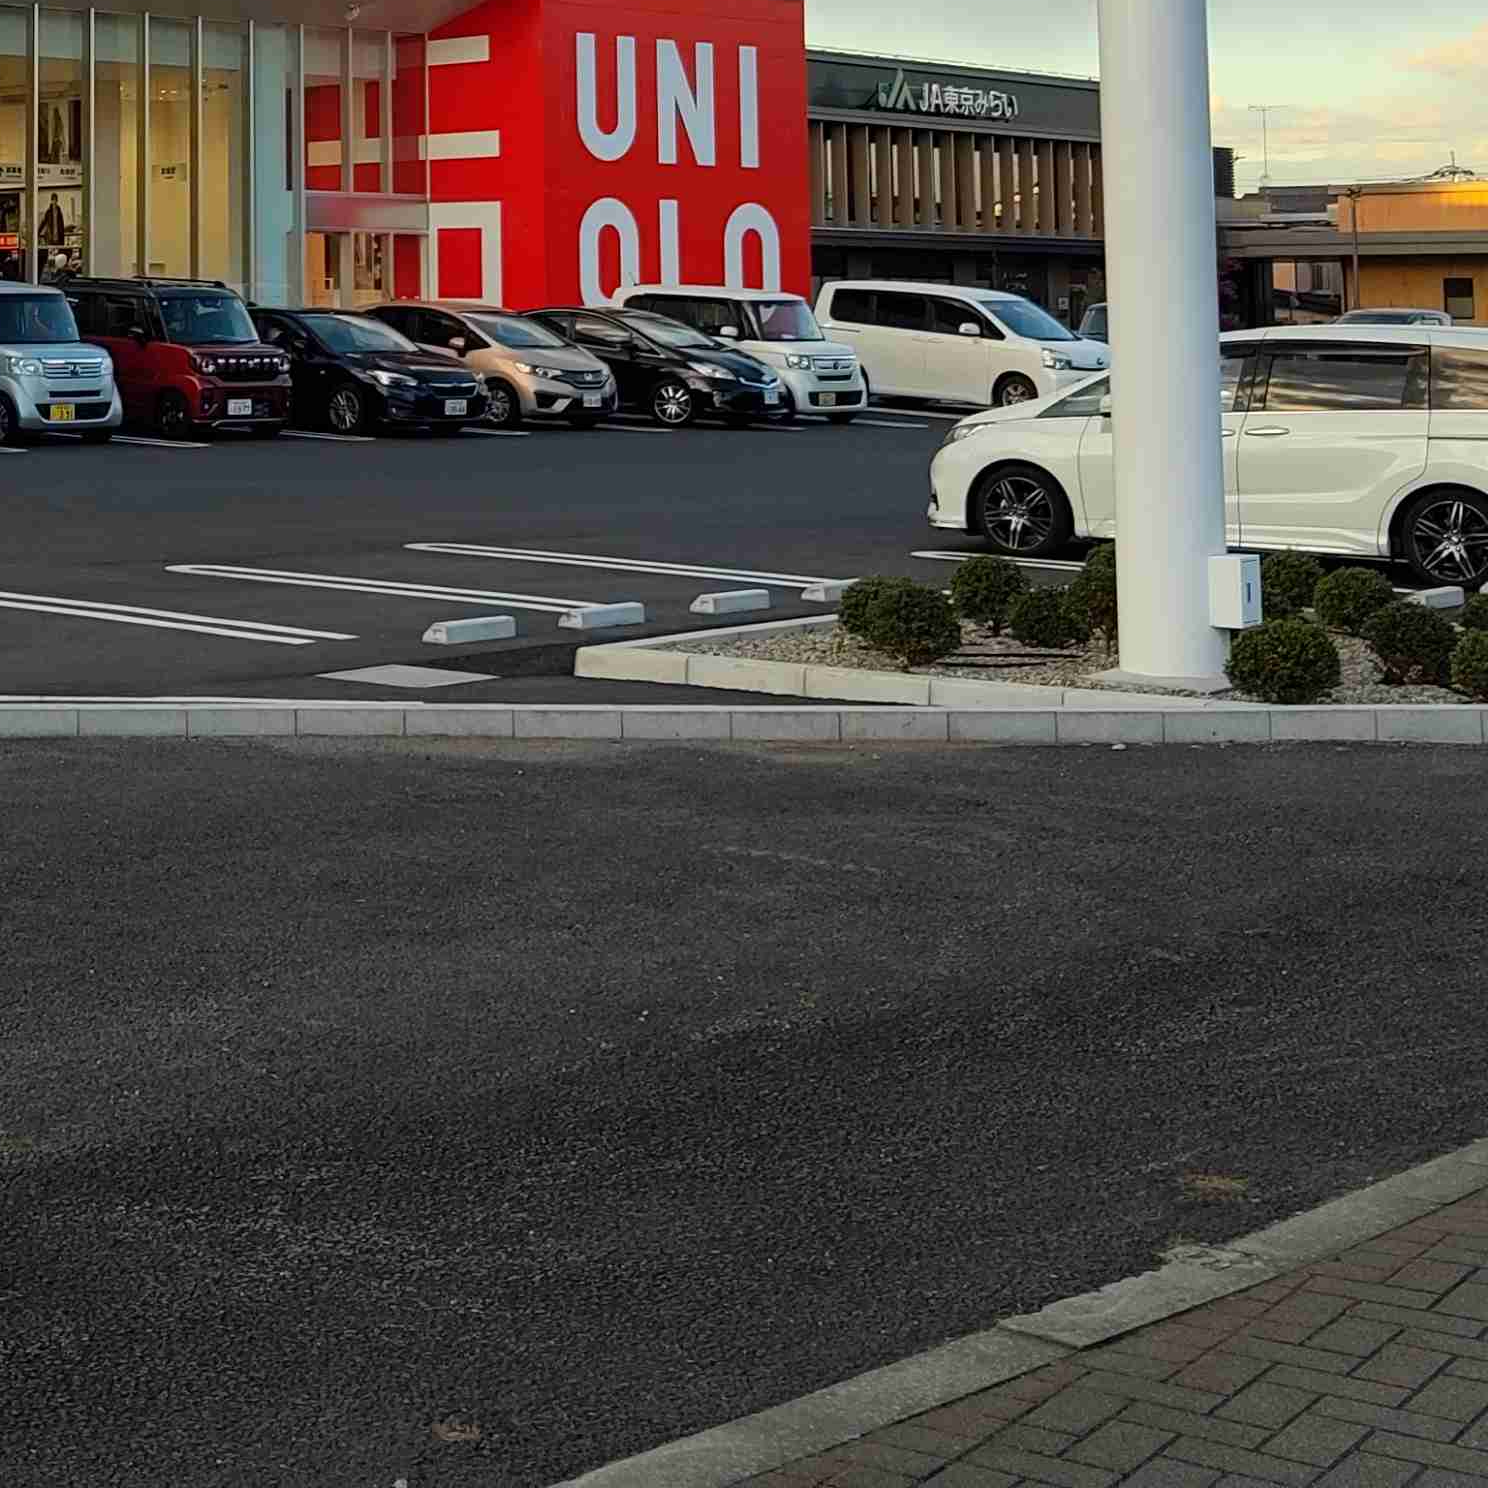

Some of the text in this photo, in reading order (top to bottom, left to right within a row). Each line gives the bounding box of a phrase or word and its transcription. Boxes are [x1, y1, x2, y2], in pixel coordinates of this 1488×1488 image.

[575, 31, 760, 169] UNI
[919, 82, 1019, 119] JA東京みらい
